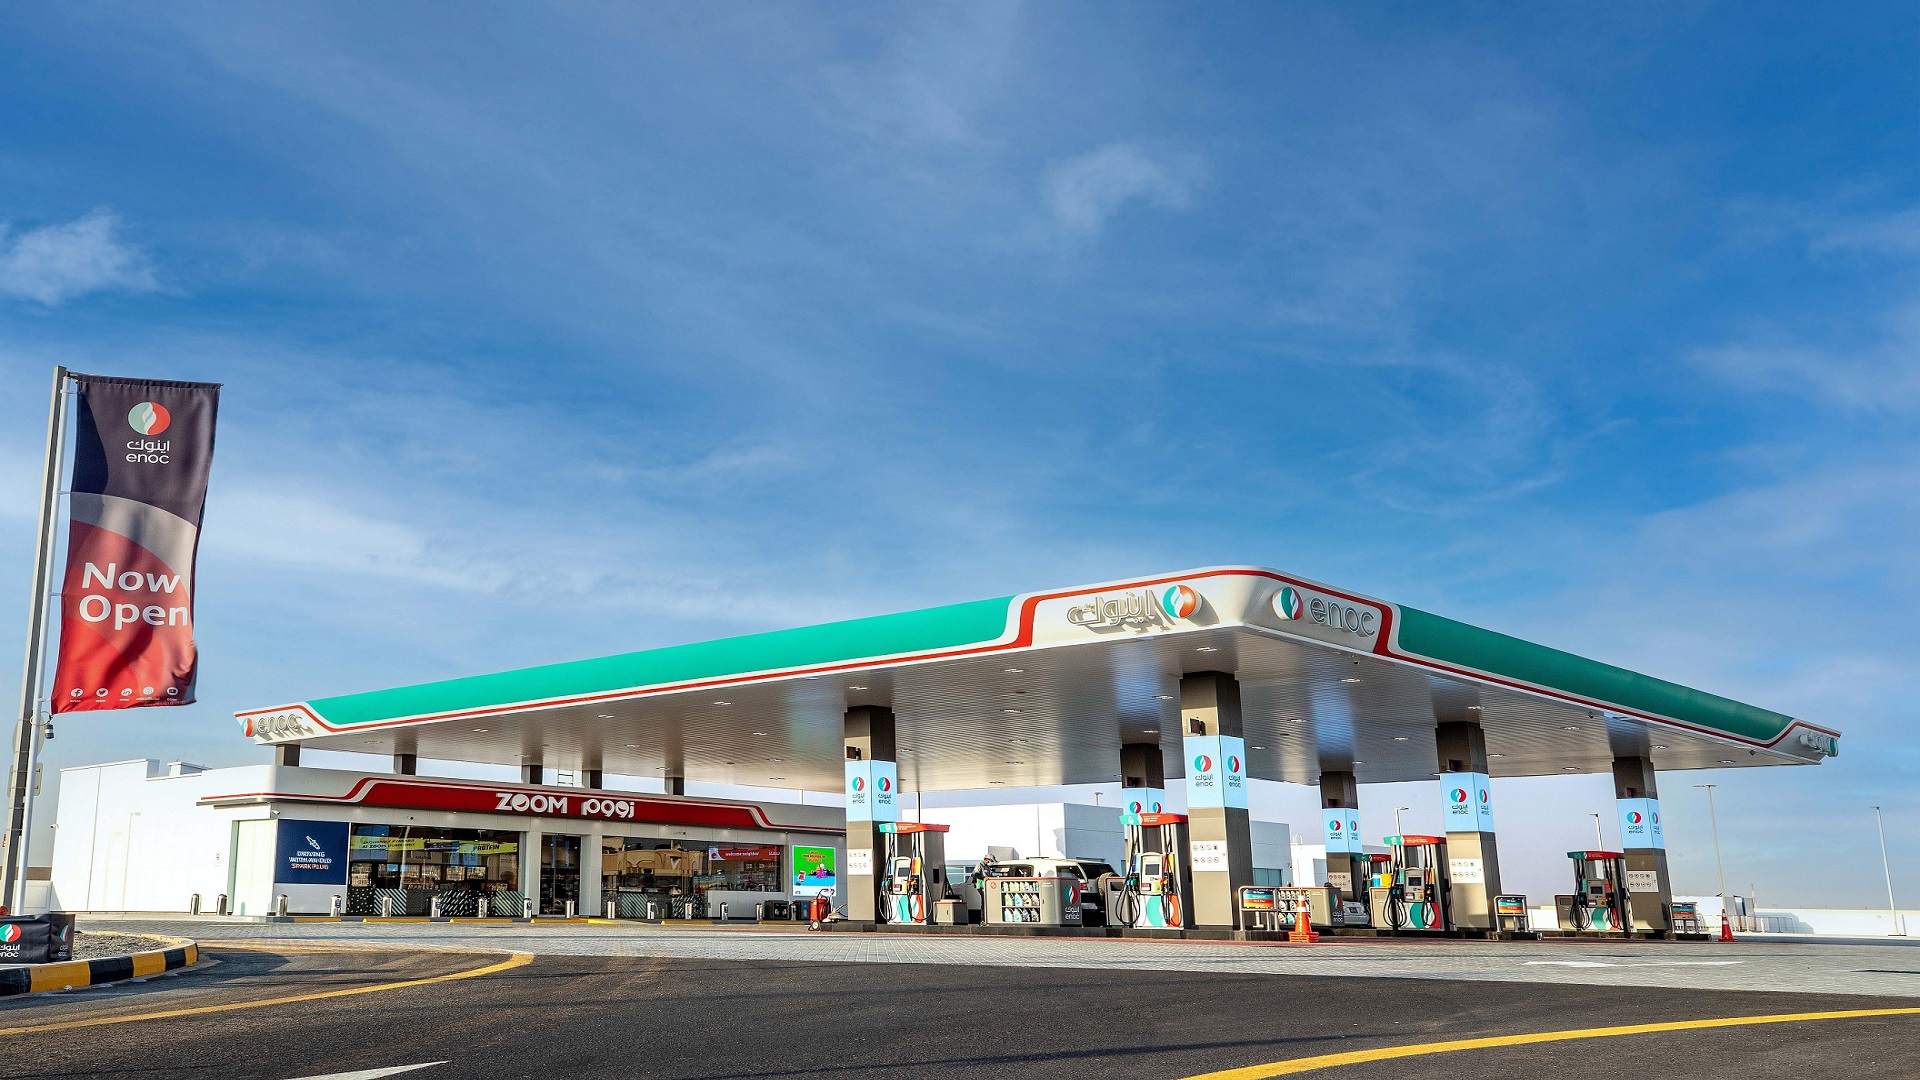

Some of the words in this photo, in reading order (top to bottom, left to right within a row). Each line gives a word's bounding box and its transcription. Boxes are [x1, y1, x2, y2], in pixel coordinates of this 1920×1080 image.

[126, 439, 170, 454] اينوك
[125, 453, 170, 464] enoc
[81, 562, 181, 594] Now
[79, 594, 188, 631] Open
[1309, 597, 1375, 637] enoc
[257, 713, 303, 733] enoc
[495, 792, 568, 814] ZOOM
